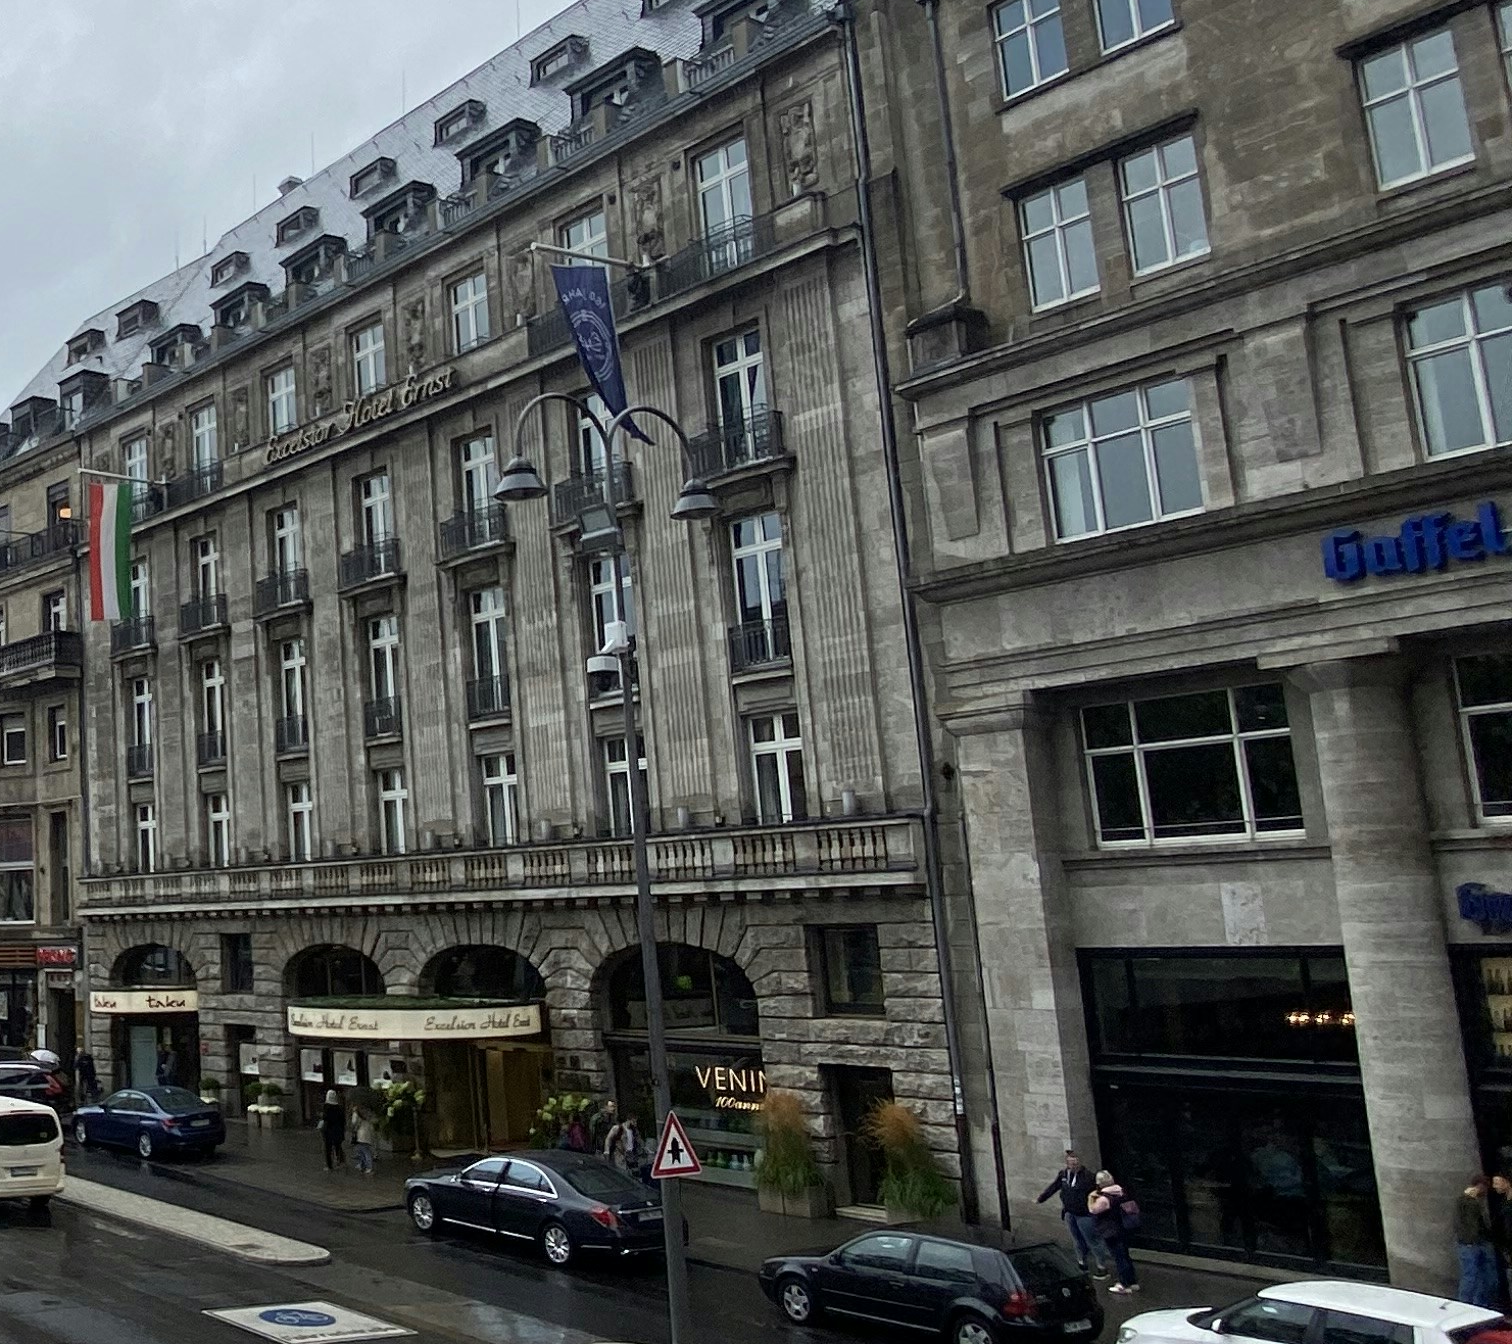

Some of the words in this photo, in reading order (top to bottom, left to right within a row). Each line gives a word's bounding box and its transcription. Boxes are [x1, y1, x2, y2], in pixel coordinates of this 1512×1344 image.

[337, 390, 394, 436] Hotel
[400, 367, 456, 406] Ernst
[1321, 501, 1505, 582] Gaffel
[145, 995, 186, 1009] taku
[424, 1014, 477, 1031] Excelsior
